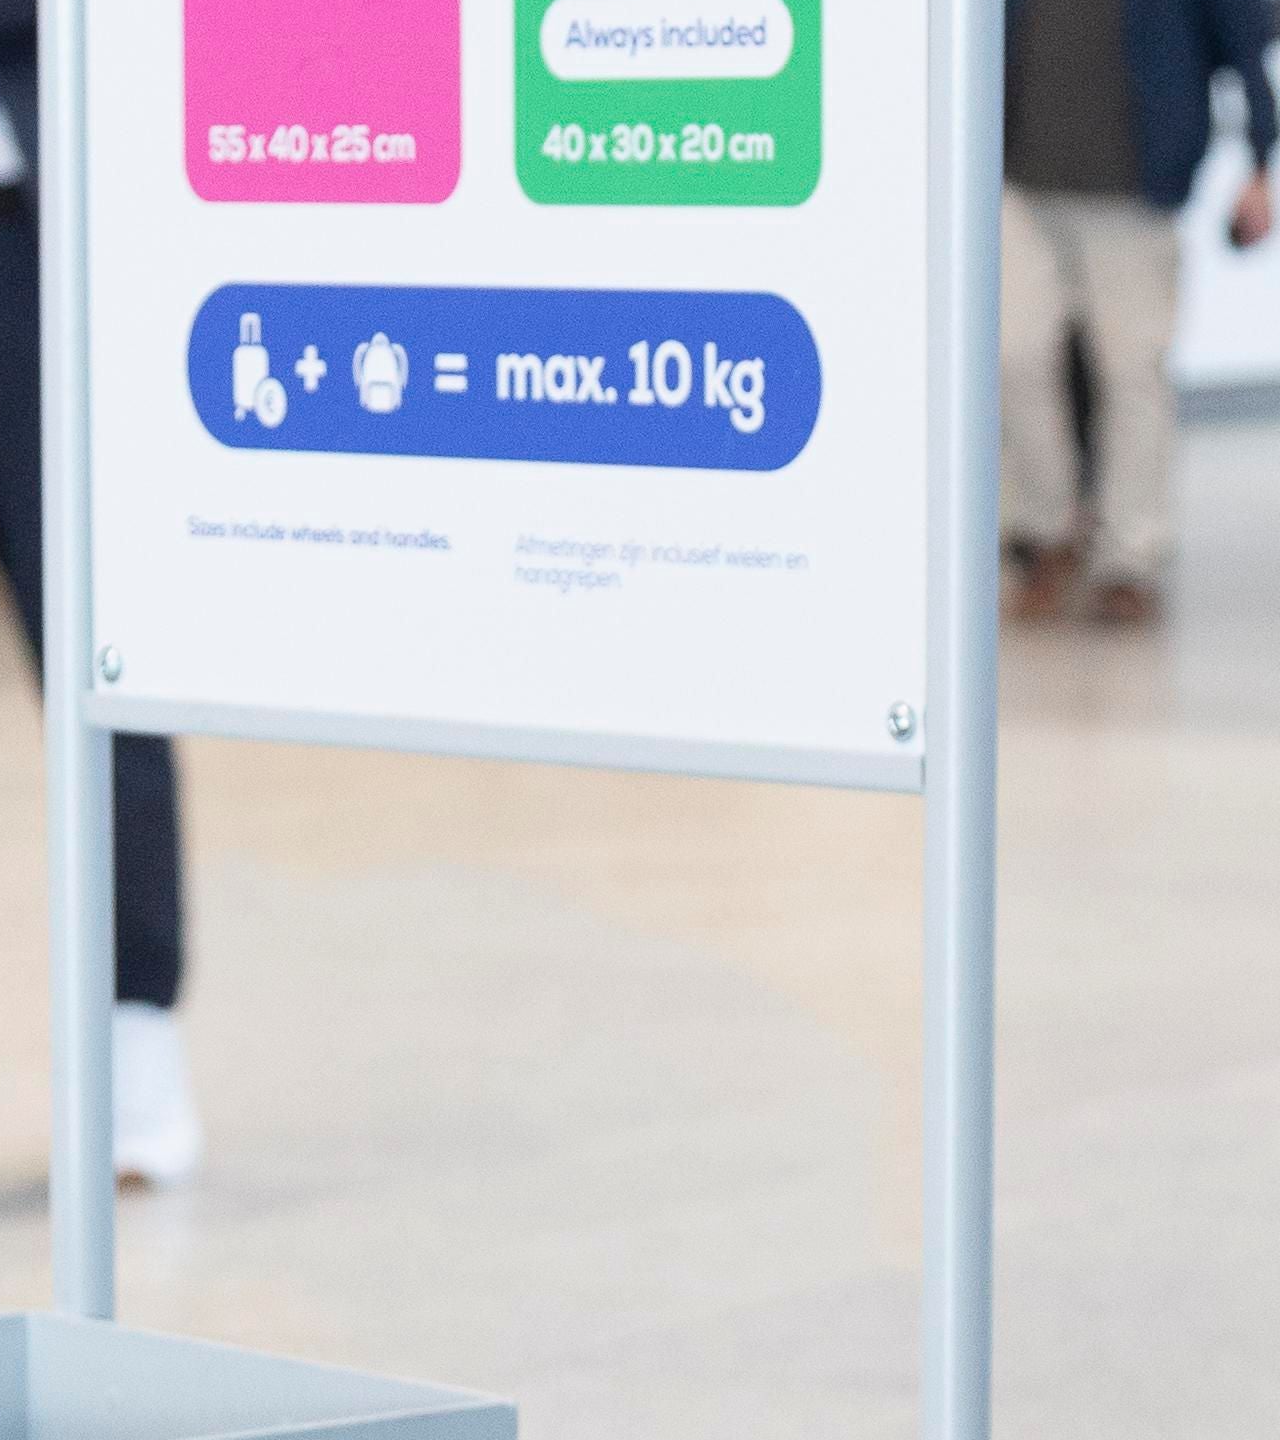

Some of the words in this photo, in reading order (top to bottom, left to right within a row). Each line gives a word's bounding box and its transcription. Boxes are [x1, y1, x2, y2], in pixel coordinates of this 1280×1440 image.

[565, 20, 654, 56] Always
[660, 16, 766, 48] included
[208, 124, 247, 163] 55
[269, 123, 309, 163] 40
[331, 123, 370, 164] 25
[372, 133, 417, 163] cm
[542, 123, 585, 162] 40
[587, 132, 607, 162] x
[611, 122, 654, 162] 30
[658, 132, 677, 162] x
[680, 122, 724, 162] 20
[728, 132, 774, 162] cm
[496, 353, 619, 404] max.
[627, 339, 693, 408] 10
[704, 340, 766, 434] kg
